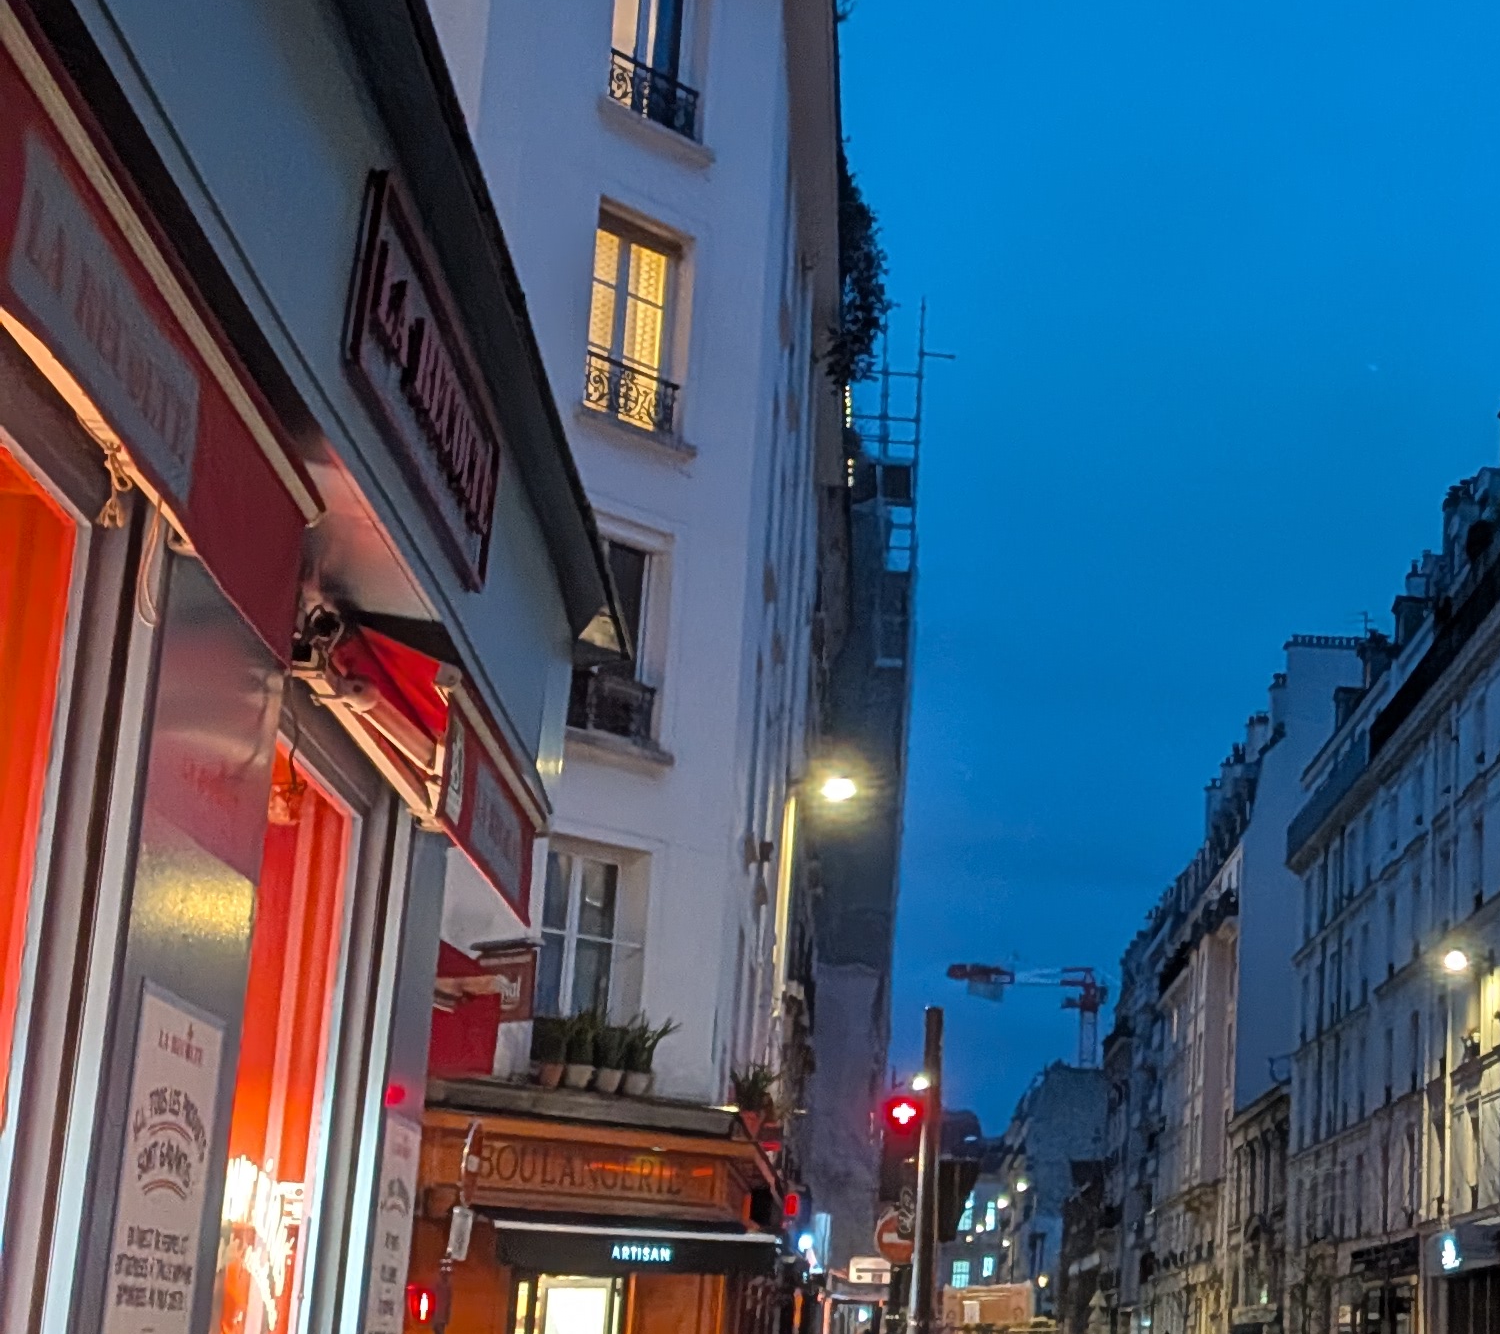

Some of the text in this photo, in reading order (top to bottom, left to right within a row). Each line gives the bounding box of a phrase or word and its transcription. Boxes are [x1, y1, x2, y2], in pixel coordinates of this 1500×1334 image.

[371, 241, 408, 369] LA
[479, 1143, 683, 1196] BOULANGERIE
[611, 1244, 673, 1262] ARTISAN
